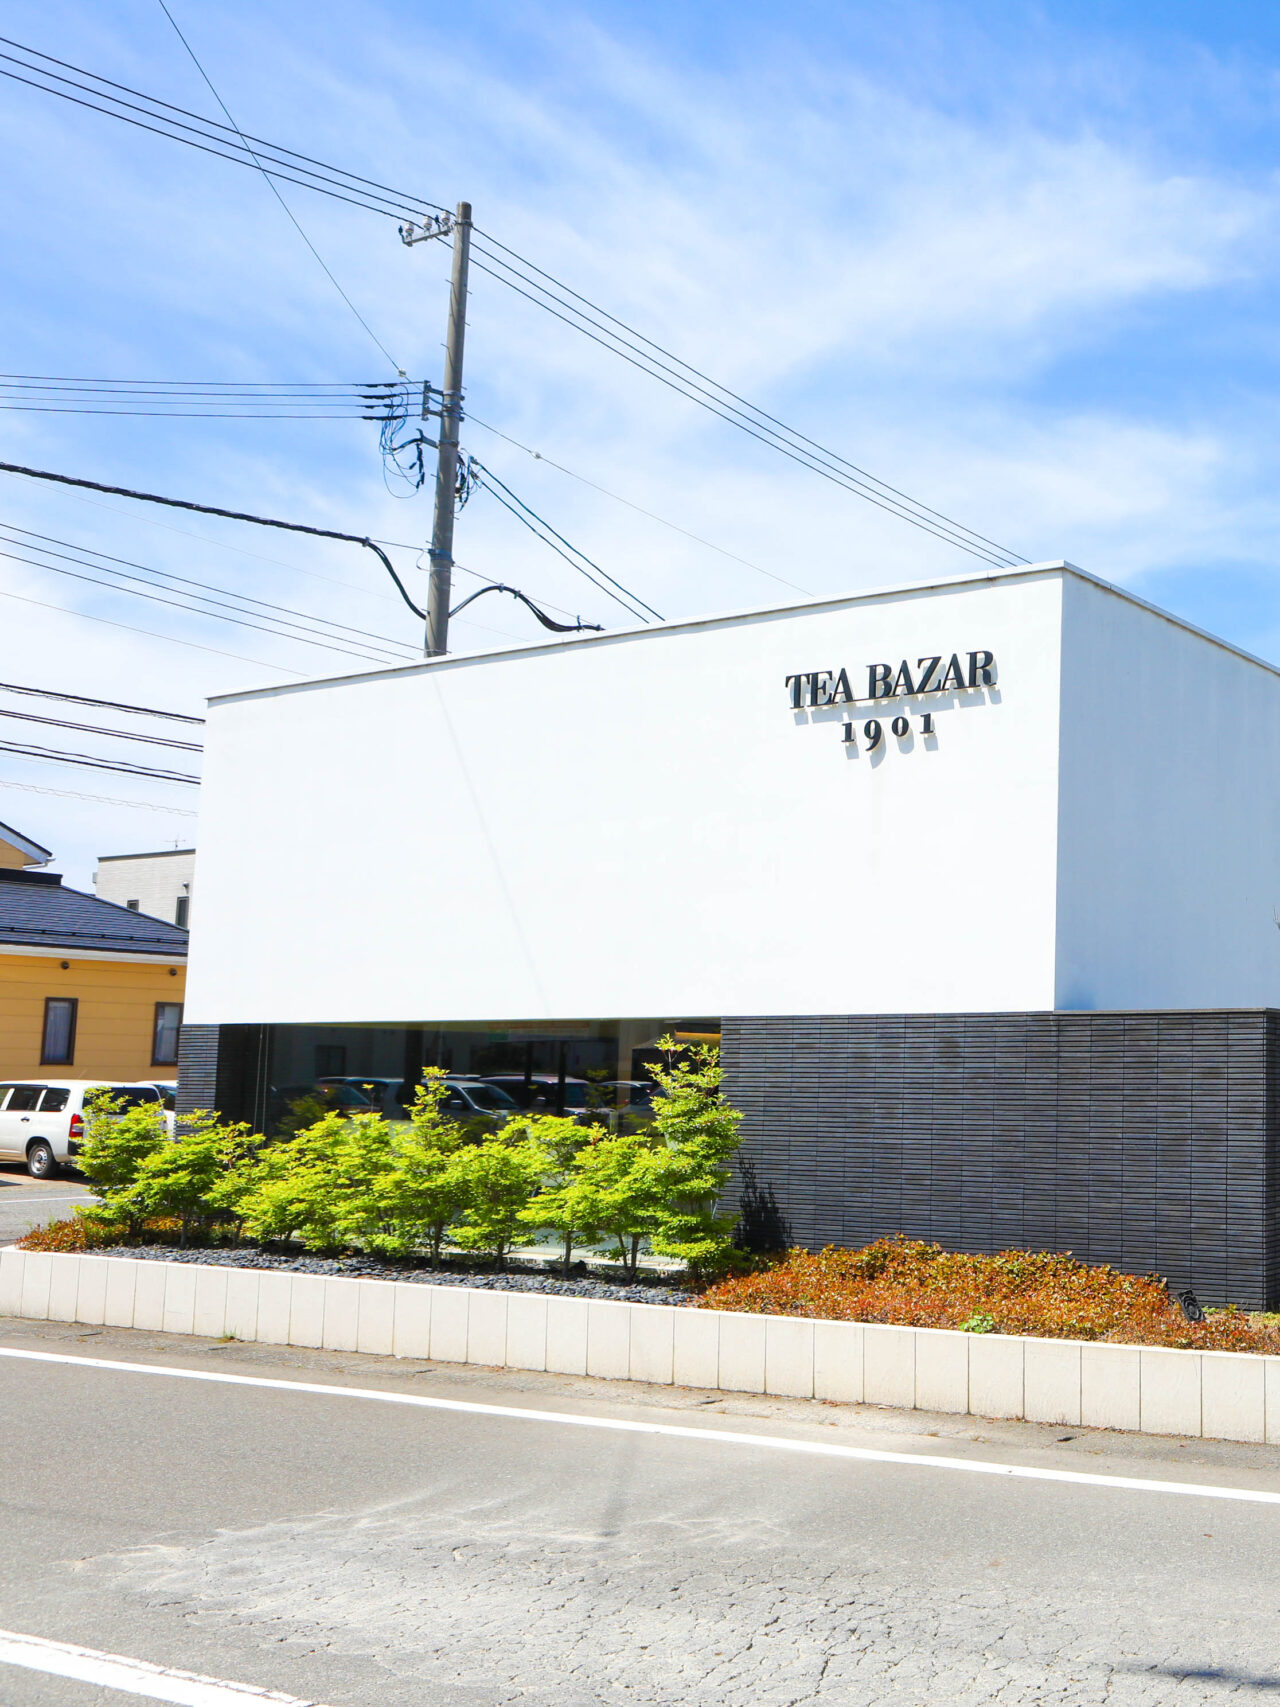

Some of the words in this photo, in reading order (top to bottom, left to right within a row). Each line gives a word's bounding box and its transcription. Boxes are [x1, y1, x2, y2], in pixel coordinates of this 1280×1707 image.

[785, 667, 857, 710] TEA
[866, 650, 997, 701] BAZAR
[841, 712, 935, 752] 1901
